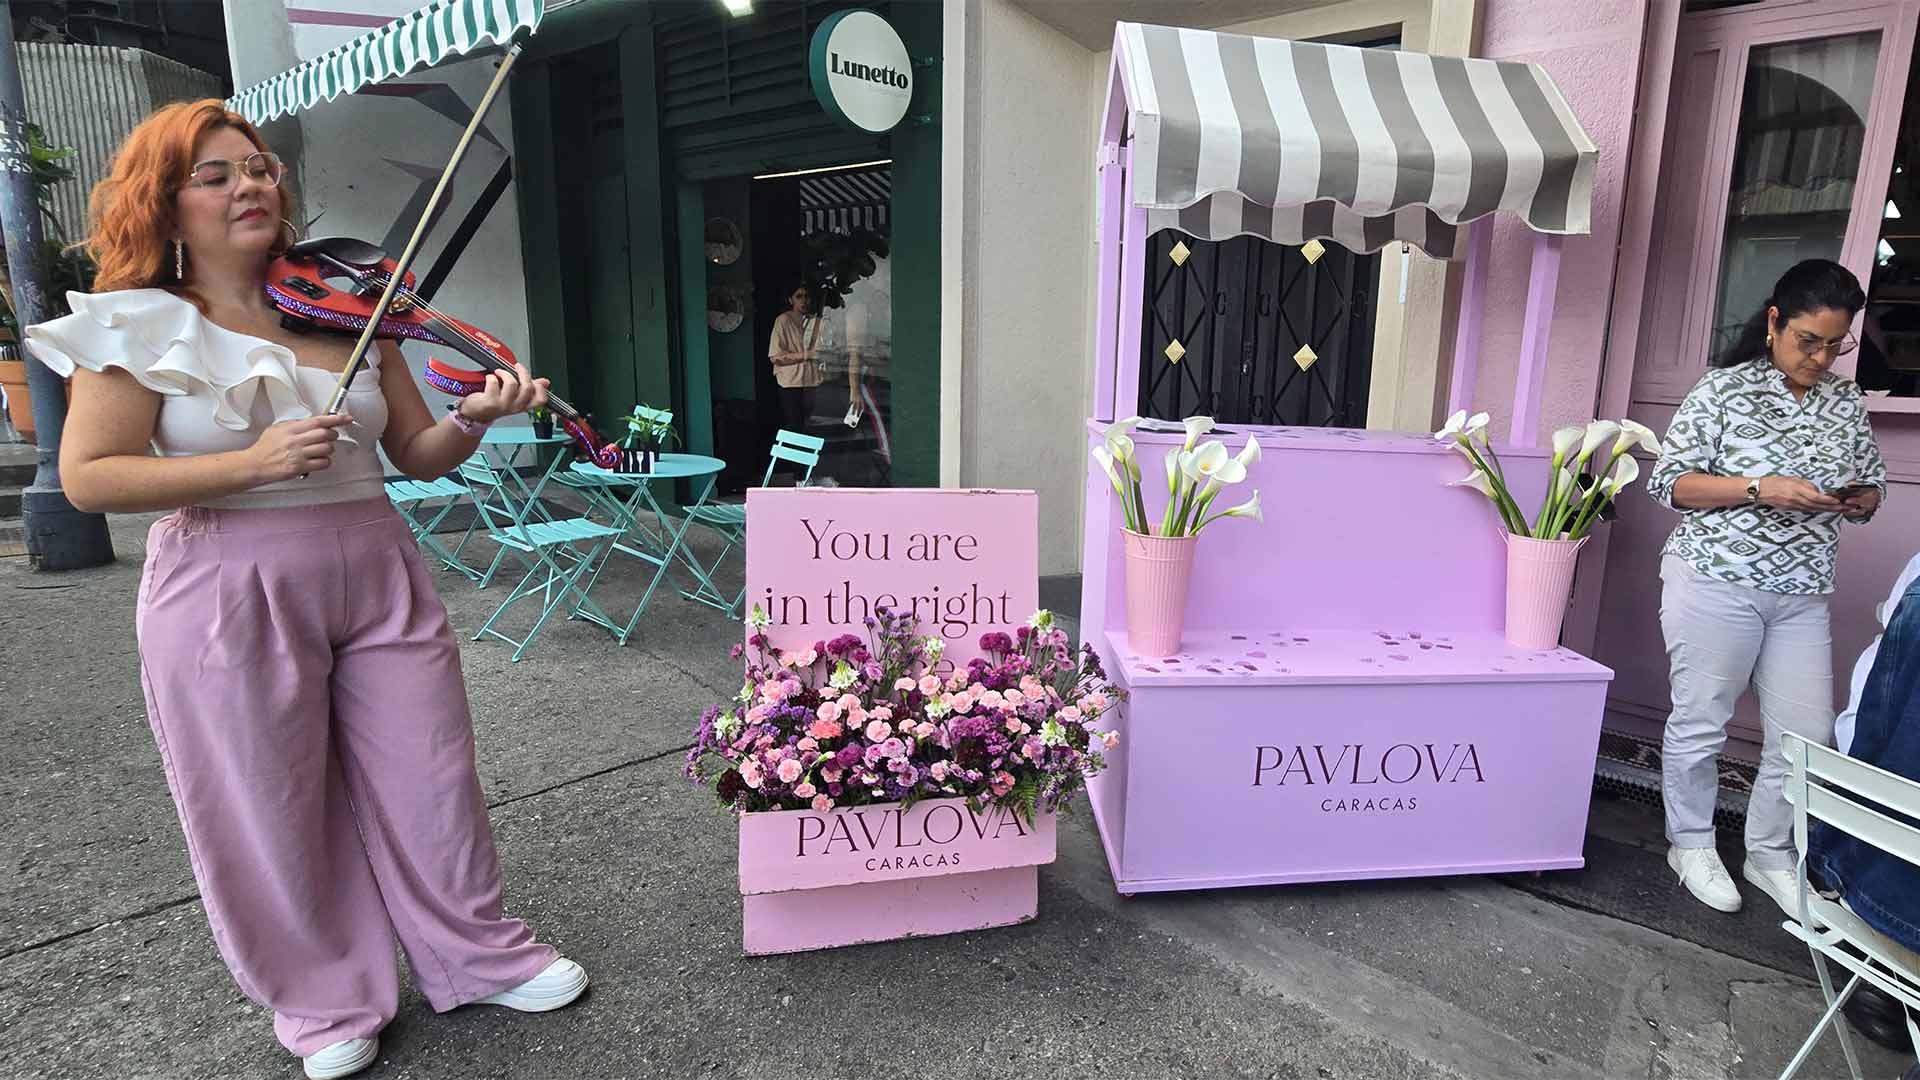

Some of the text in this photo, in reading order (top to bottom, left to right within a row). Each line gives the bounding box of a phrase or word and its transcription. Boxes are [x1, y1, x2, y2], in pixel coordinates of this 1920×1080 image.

[831, 52, 909, 89] Lunetto
[800, 518, 979, 561] You are
[765, 580, 1014, 639] in the right
[1252, 743, 1486, 786] PAVLOVA
[1320, 797, 1418, 812] CARACAS
[796, 801, 1028, 857] PAVLOVA
[865, 852, 961, 871] CARACAS
